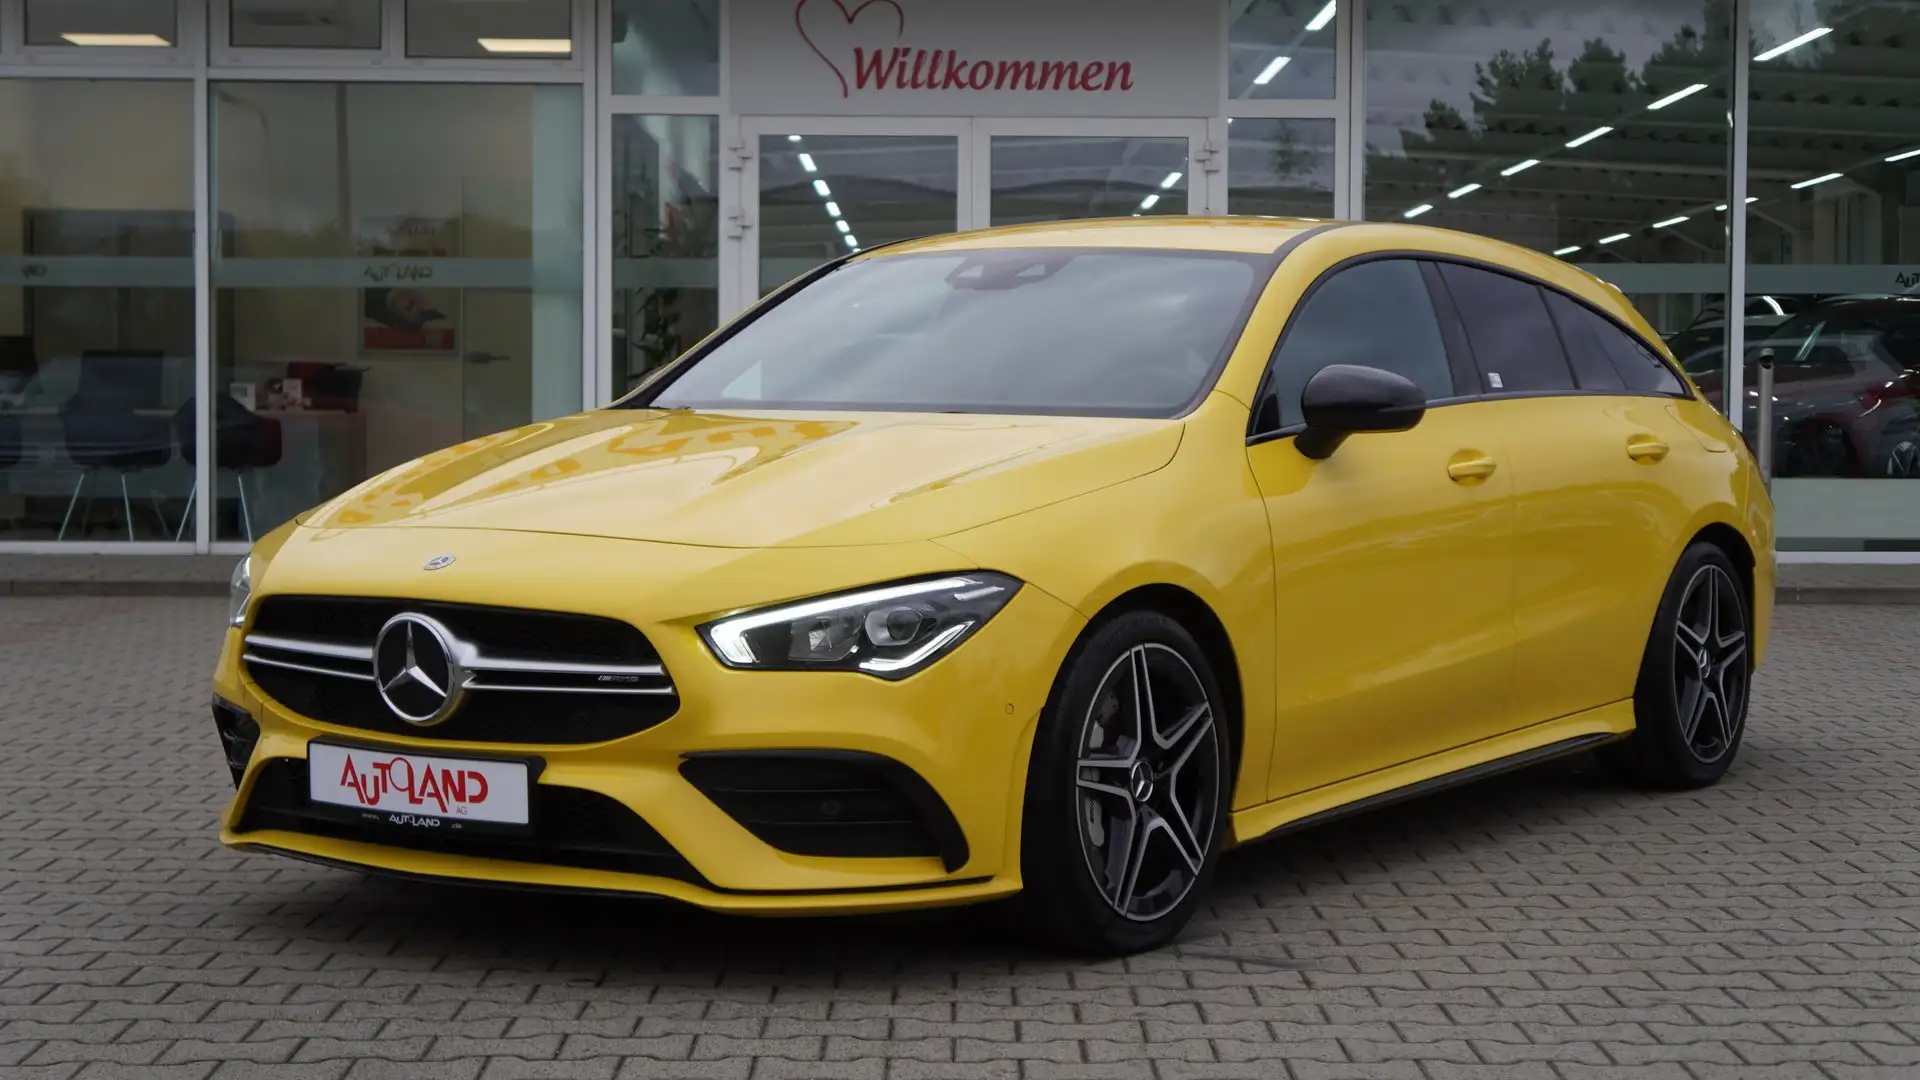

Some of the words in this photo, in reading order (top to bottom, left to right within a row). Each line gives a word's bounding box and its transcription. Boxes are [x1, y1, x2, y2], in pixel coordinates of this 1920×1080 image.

[853, 47, 1134, 91] Willkommen
[340, 753, 488, 814] AUTOLAND
[456, 805, 468, 815] AG
